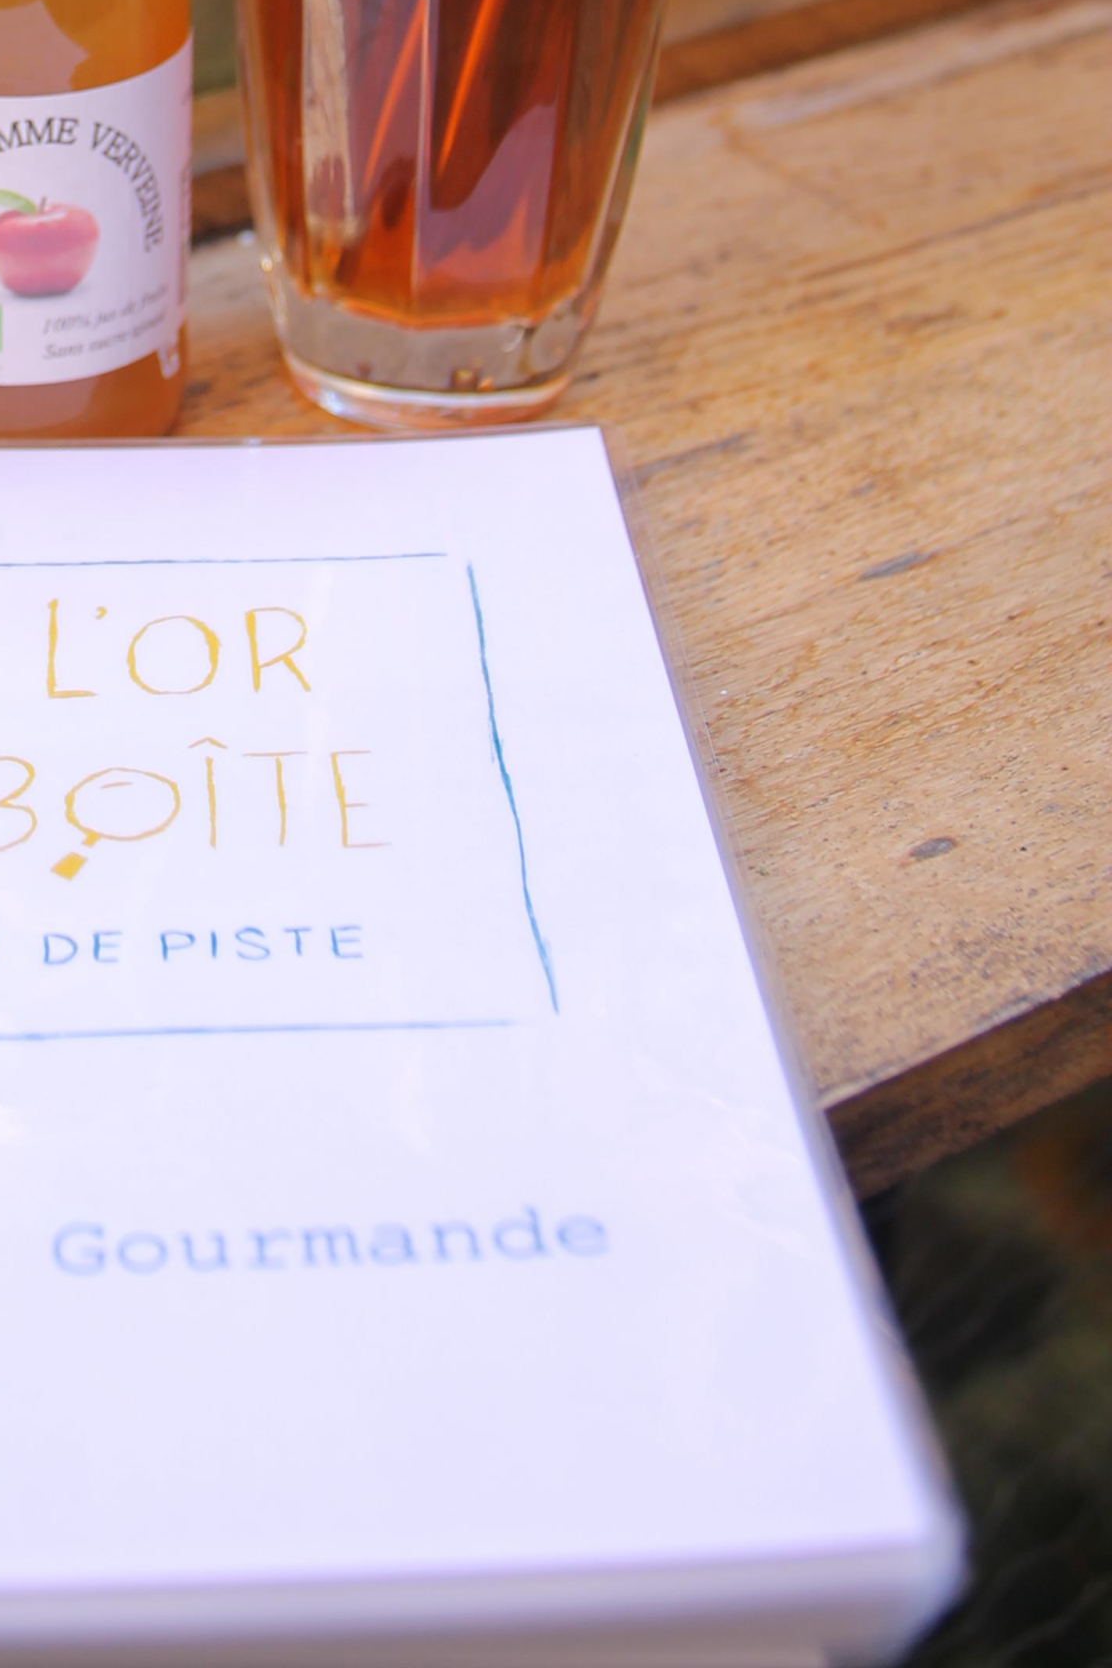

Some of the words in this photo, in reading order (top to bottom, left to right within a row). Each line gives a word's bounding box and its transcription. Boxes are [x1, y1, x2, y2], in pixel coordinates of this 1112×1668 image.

[90, 121, 165, 253] VERVEINE
[47, 598, 312, 697] L'OR
[42, 929, 123, 966] DE
[160, 925, 366, 963] PISTE
[50, 1204, 612, 1277] Gourmande
